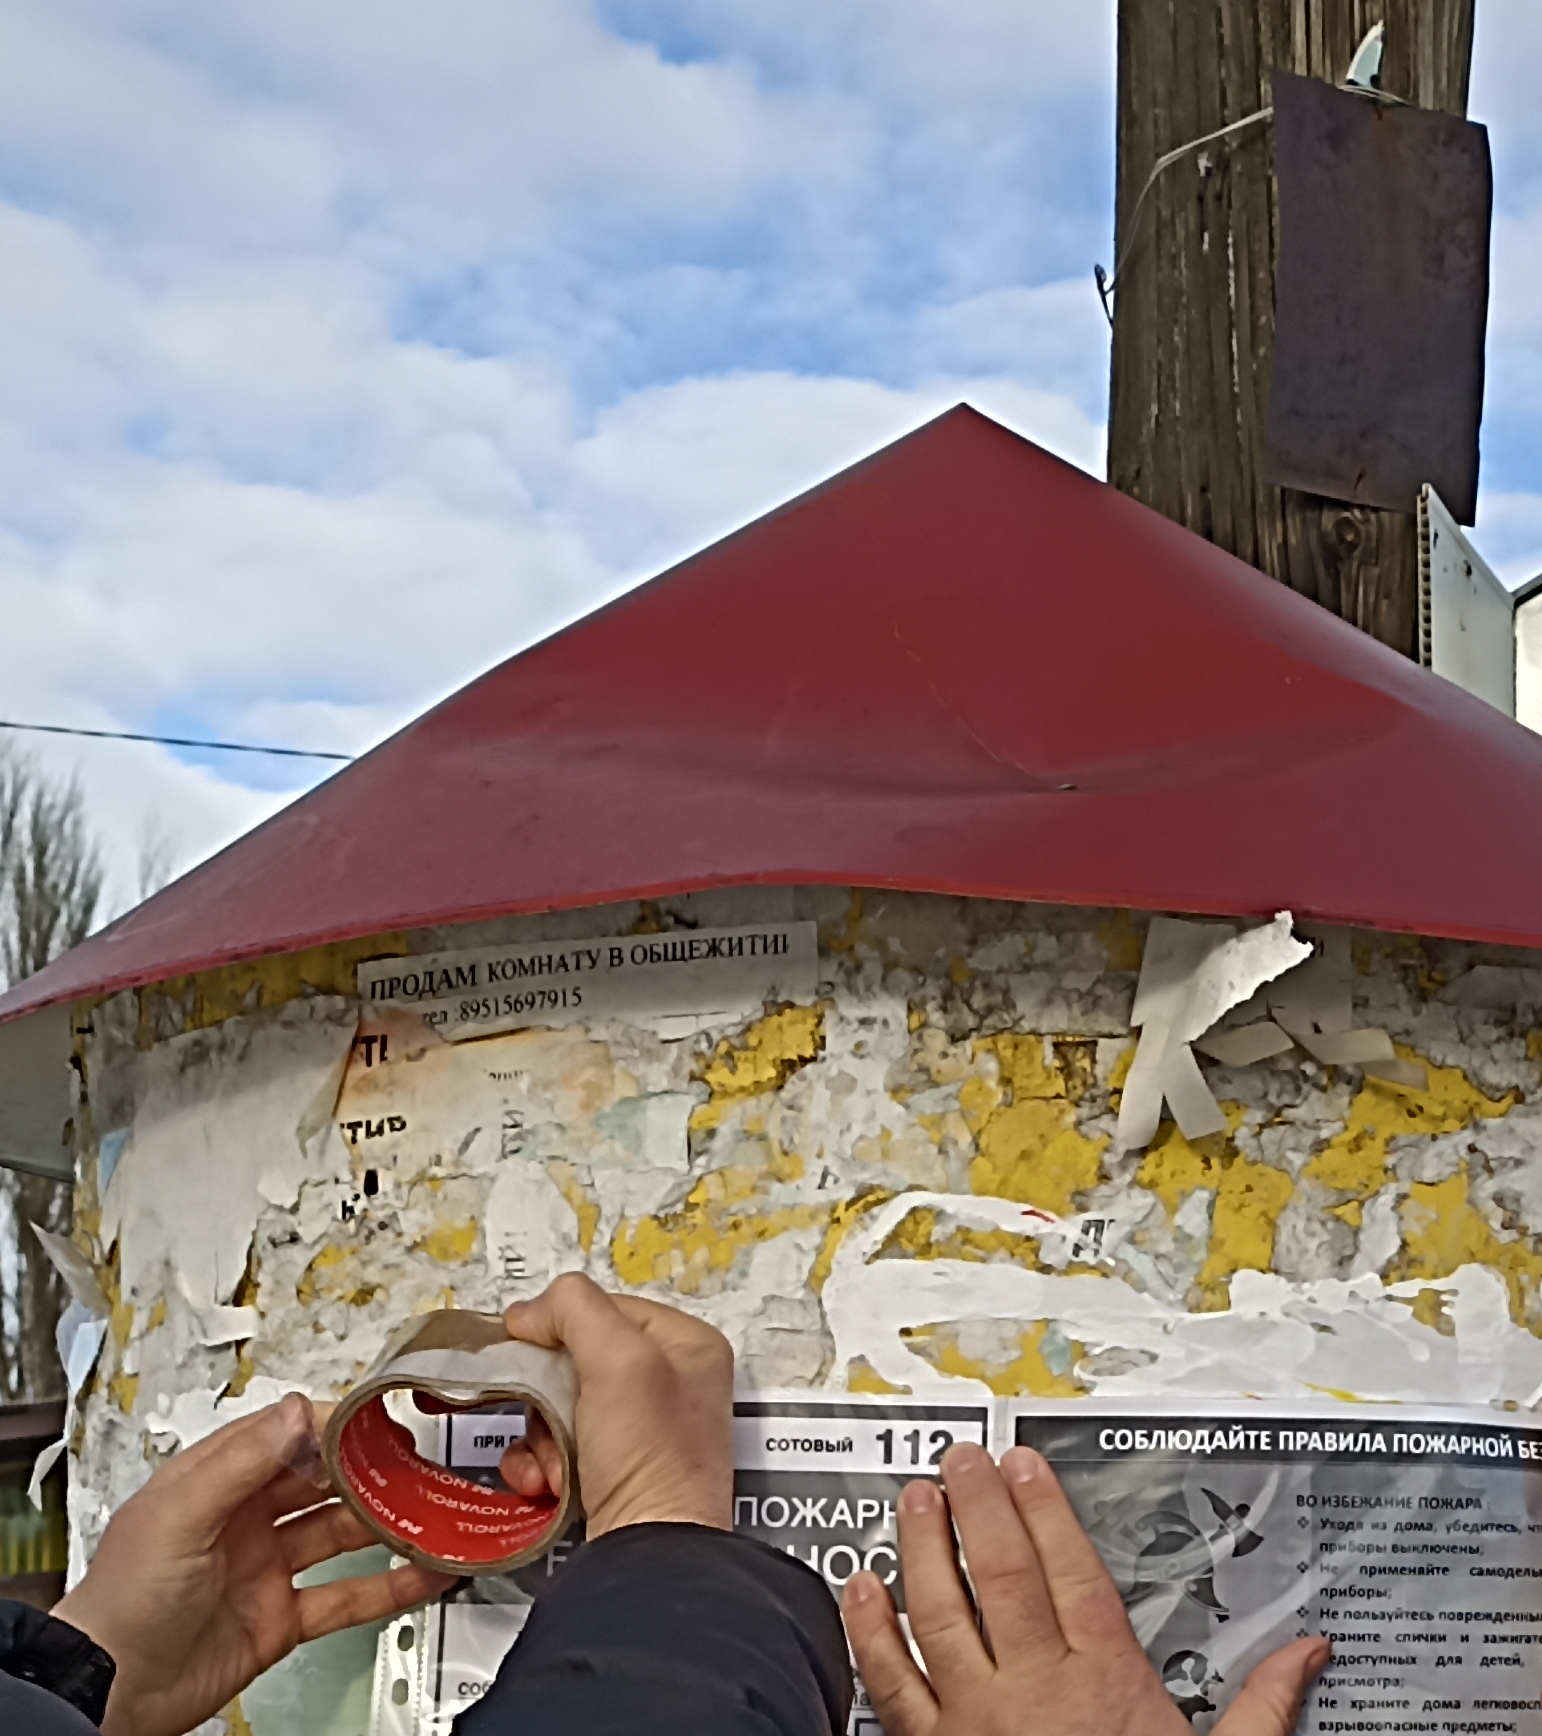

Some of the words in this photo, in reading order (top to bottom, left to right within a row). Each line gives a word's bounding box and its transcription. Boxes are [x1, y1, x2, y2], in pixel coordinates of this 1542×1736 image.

[370, 964, 477, 1002] ПРОДАМ
[487, 948, 601, 984] КОМНАТУ
[608, 947, 625, 967] В
[473, 1434, 505, 1449] ПРИ
[875, 1428, 954, 1466] 112
[1099, 1426, 1272, 1452] СОБЛЮДАЙТЕ
[1279, 1431, 1385, 1454] ПРАВИЛА
[1393, 1432, 1514, 1459] ПОЖАРНОЙ
[1296, 1494, 1318, 1508] ВО
[1321, 1495, 1413, 1511] ИЗБЕЖАНИЕ
[1418, 1496, 1483, 1511] ПОЖАРА
[1319, 1518, 1364, 1532] Уходя
[1445, 1519, 1523, 1536] убедитесь,
[1319, 1540, 1387, 1556] приборы
[1391, 1542, 1486, 1557] выключены;
[1359, 1563, 1450, 1579] применяйте
[1319, 1607, 1339, 1620] Не
[1343, 1607, 1435, 1623] пользуйтесь
[1395, 1632, 1447, 1644] спички
[1460, 1634, 1470, 1644] и
[1327, 1655, 1417, 1668] едоступных
[1435, 1656, 1463, 1669] для
[1319, 1675, 1406, 1690] присмотра;
[1318, 1697, 1338, 1709] Не
[1350, 1699, 1411, 1712] храните
[1422, 1699, 1461, 1711] дома
[1318, 1721, 1439, 1735] взрывоопасные
[1442, 1721, 1518, 1735] предметы;
